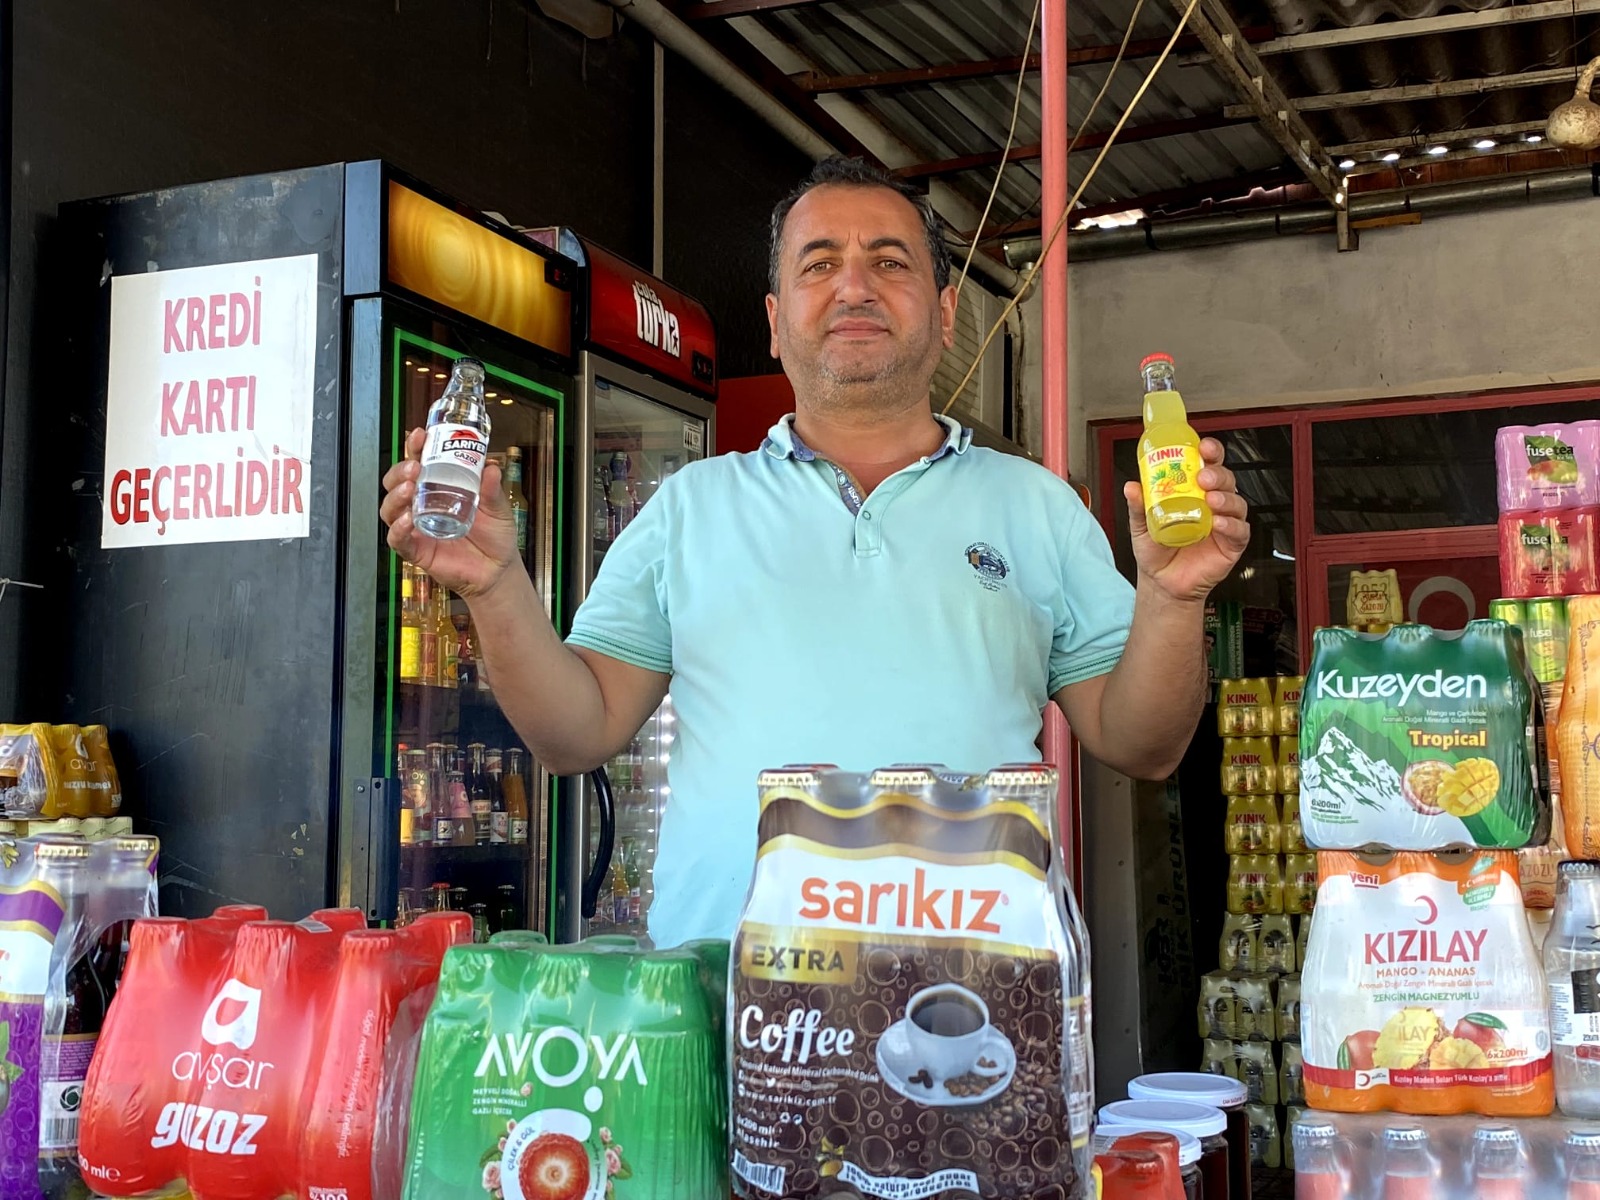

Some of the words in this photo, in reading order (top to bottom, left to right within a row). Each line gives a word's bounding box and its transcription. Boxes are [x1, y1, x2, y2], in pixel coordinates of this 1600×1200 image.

[163, 276, 262, 354] KREDİ
[160, 375, 257, 437] KARTI
[454, 451, 478, 466] GAZOZ
[1147, 447, 1184, 465] KINIK
[1526, 444, 1574, 457] fusetea
[110, 444, 304, 536] GEÇERLİDİR
[1226, 693, 1258, 704] KINIK
[1316, 669, 1487, 707] Kuzeyden
[1408, 729, 1487, 751] Tropical
[1230, 753, 1261, 764] KINIK
[1235, 813, 1267, 825] KINIK
[798, 867, 1002, 935] sarıkız
[750, 944, 845, 972] EXTRA
[1364, 928, 1488, 965] KIZILAY
[1376, 966, 1418, 979] MANGO
[1428, 966, 1476, 977] ANANAS
[1373, 991, 1406, 1003] ZENGİN
[1408, 991, 1480, 1002] MAGNEZYUMLU
[739, 1004, 856, 1065] Coffee
[171, 1050, 275, 1092] avşar
[473, 1026, 649, 1088] AVOYA
